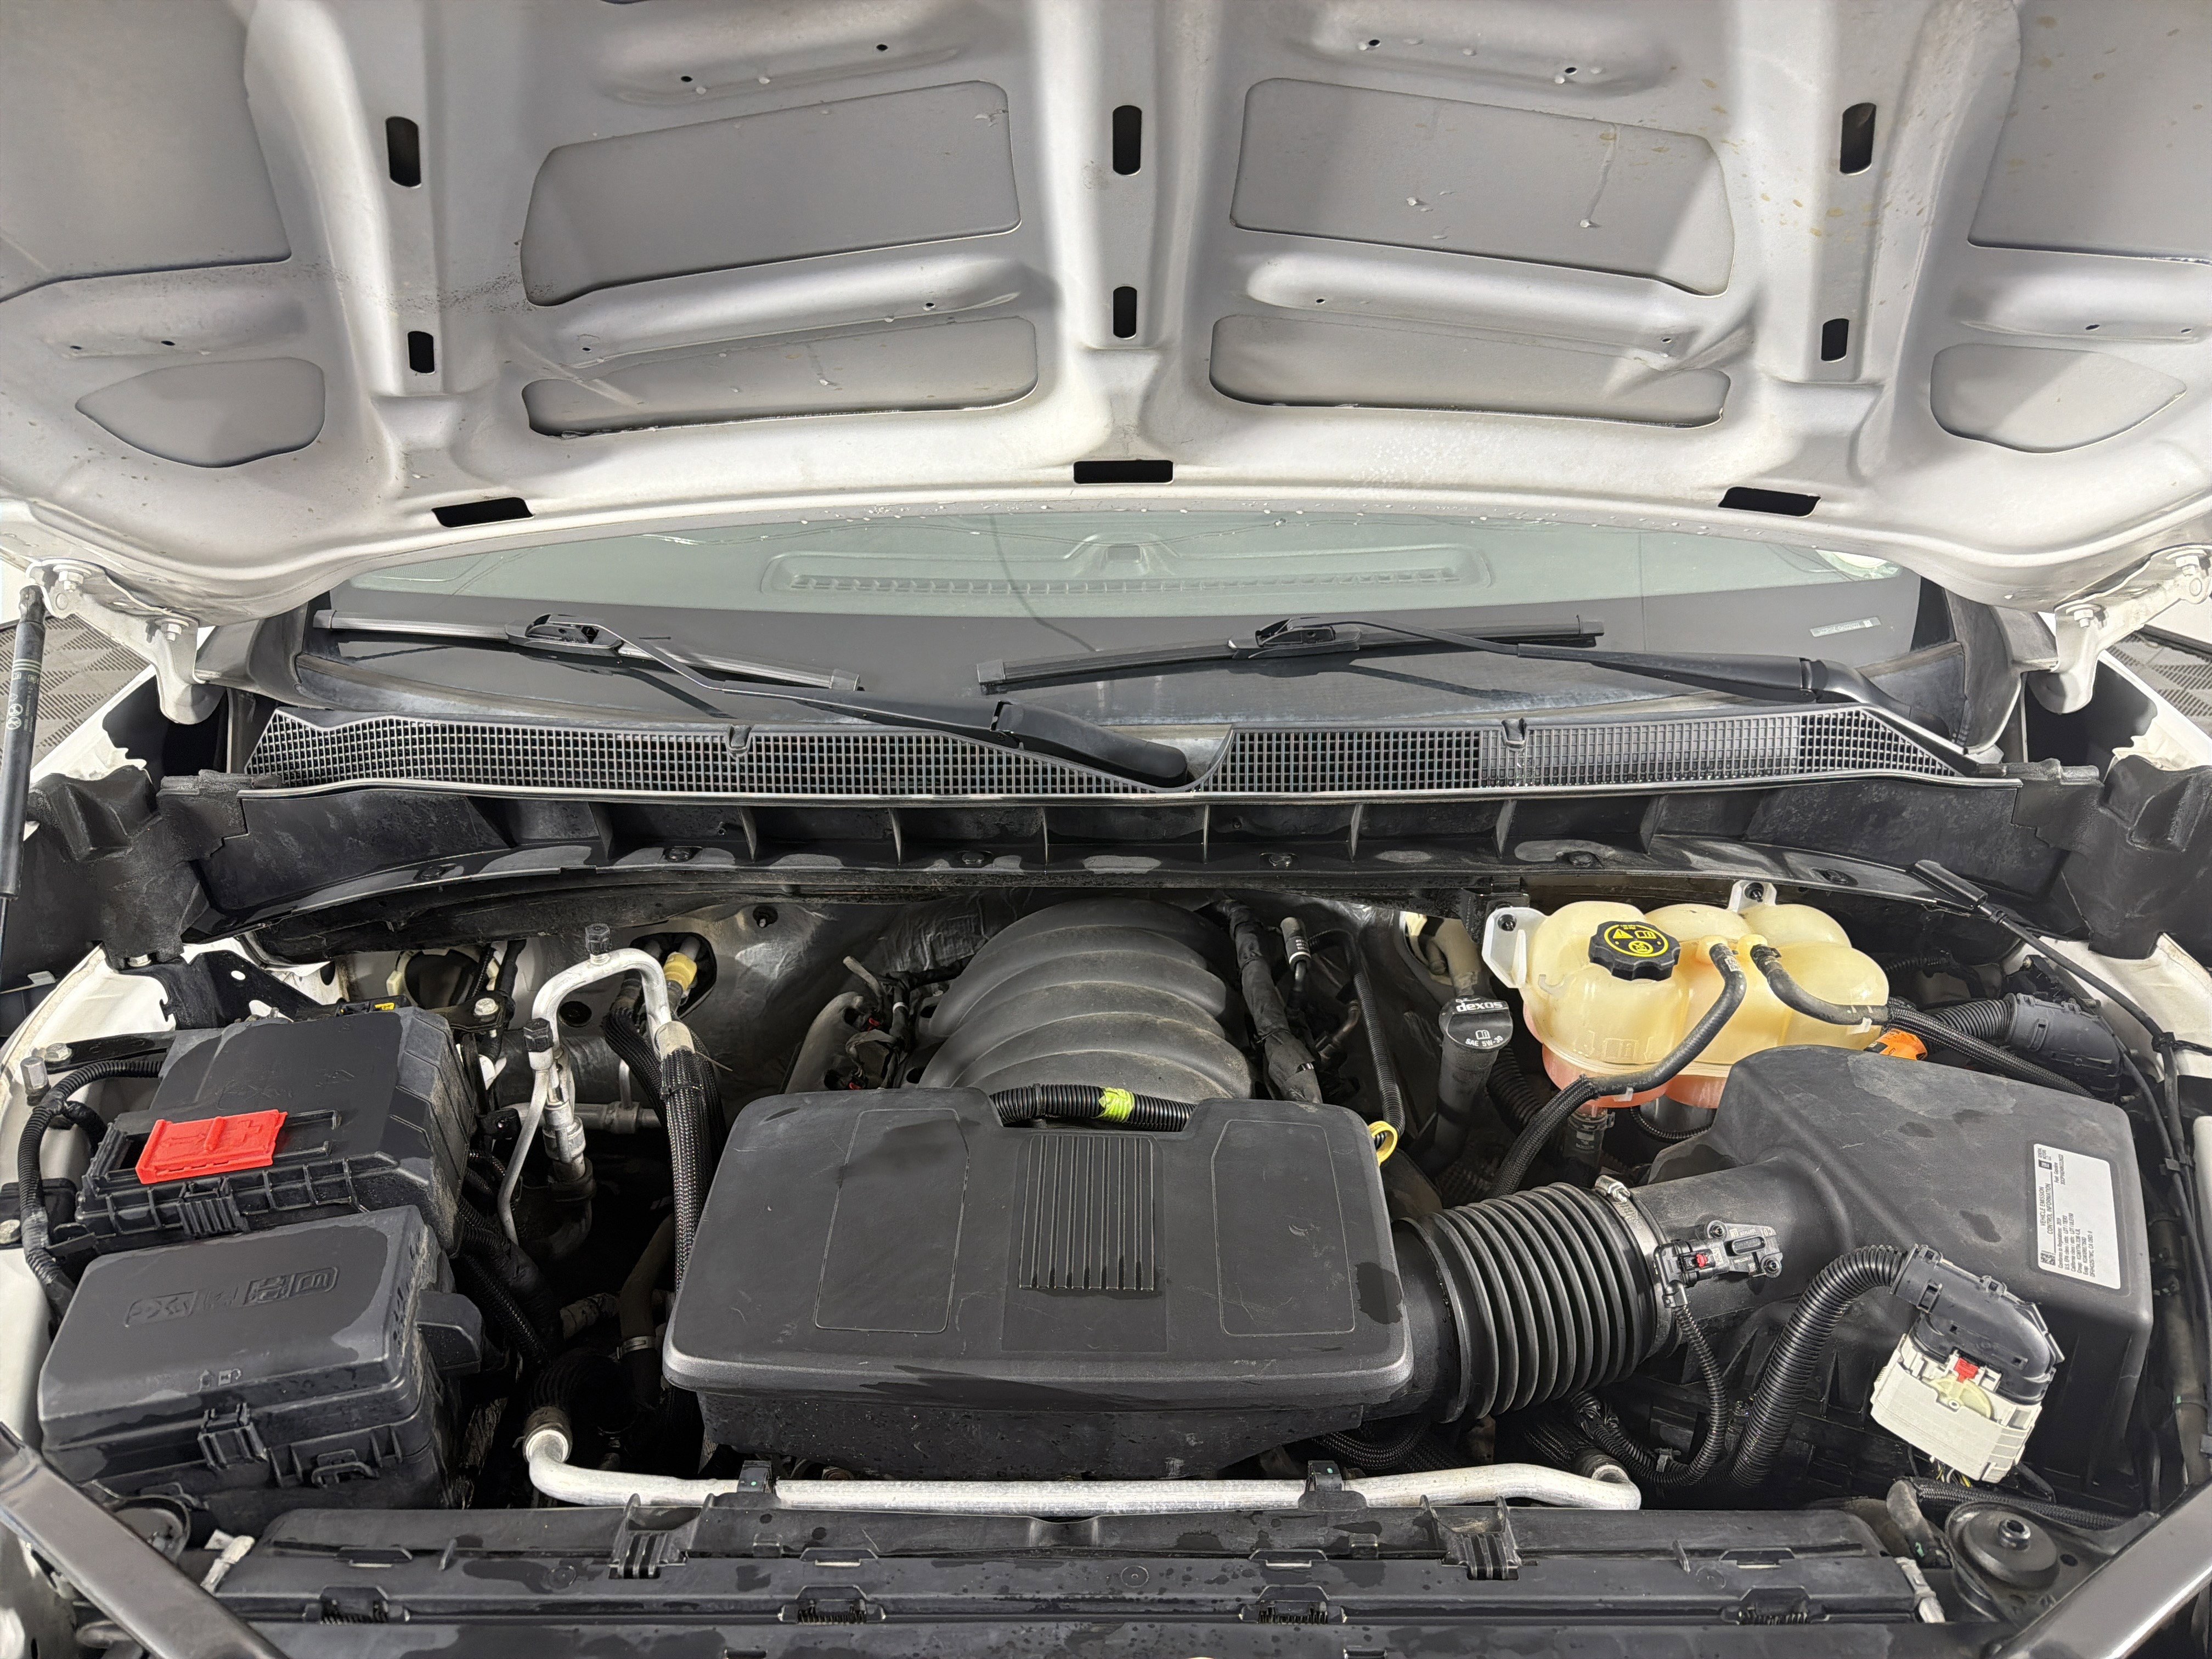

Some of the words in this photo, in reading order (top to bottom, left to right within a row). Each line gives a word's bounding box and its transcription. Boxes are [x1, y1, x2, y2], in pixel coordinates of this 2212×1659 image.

[1456, 1002, 1503, 1012] dexos
[1465, 1038, 1479, 1047] SAE
[1482, 1035, 1504, 1047] 5W-30
